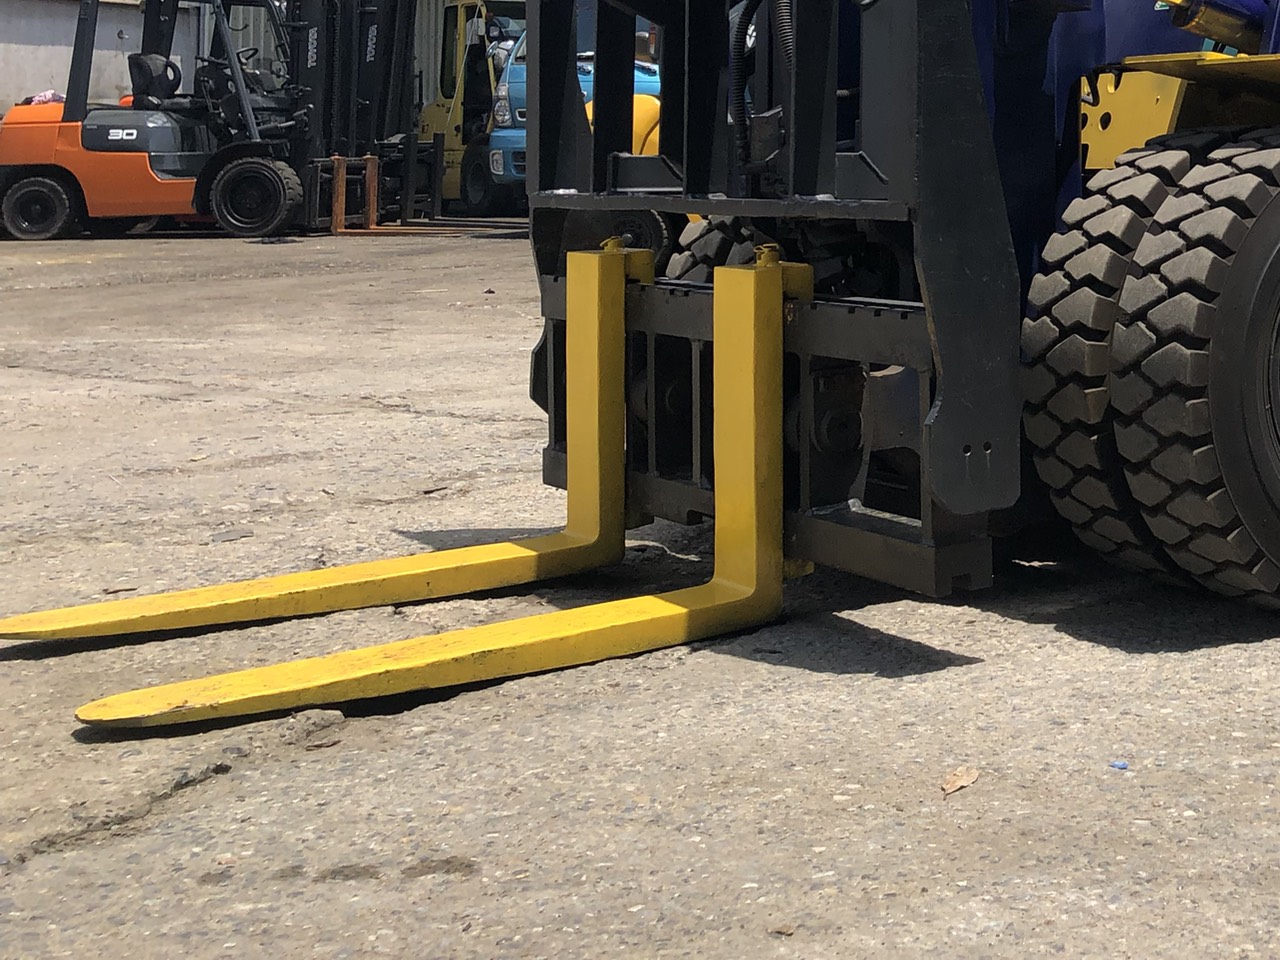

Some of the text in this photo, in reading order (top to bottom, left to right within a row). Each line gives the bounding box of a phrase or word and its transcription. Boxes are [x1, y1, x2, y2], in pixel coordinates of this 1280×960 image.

[307, 26, 318, 68] TOYOTA
[366, 24, 378, 62] TOYOTA
[107, 128, 138, 140] 30
